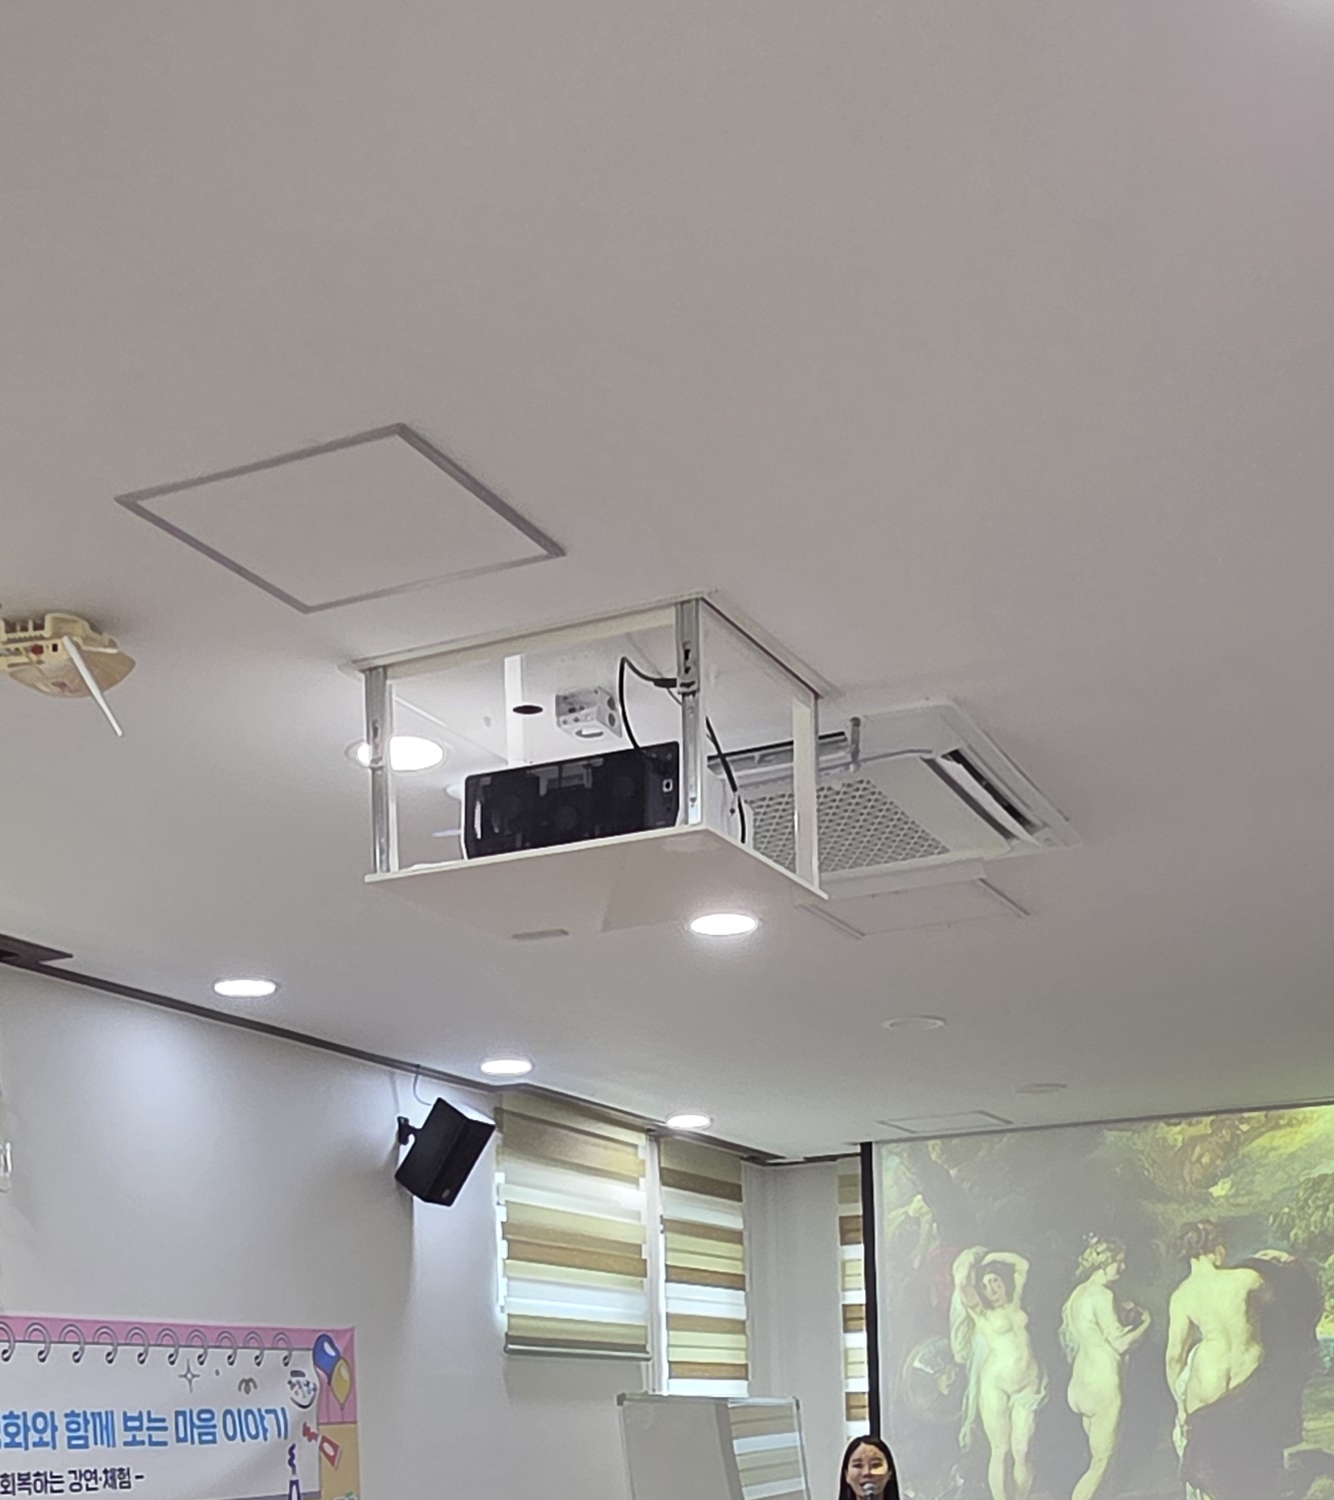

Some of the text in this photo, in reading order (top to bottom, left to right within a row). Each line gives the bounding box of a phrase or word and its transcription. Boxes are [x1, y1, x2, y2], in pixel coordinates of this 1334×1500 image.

[63, 1409, 116, 1450] 함께
[122, 1409, 169, 1448] 보는
[174, 1407, 217, 1445] 마음
[221, 1406, 289, 1443] 이야기
[0, 1470, 65, 1497] 회복하는
